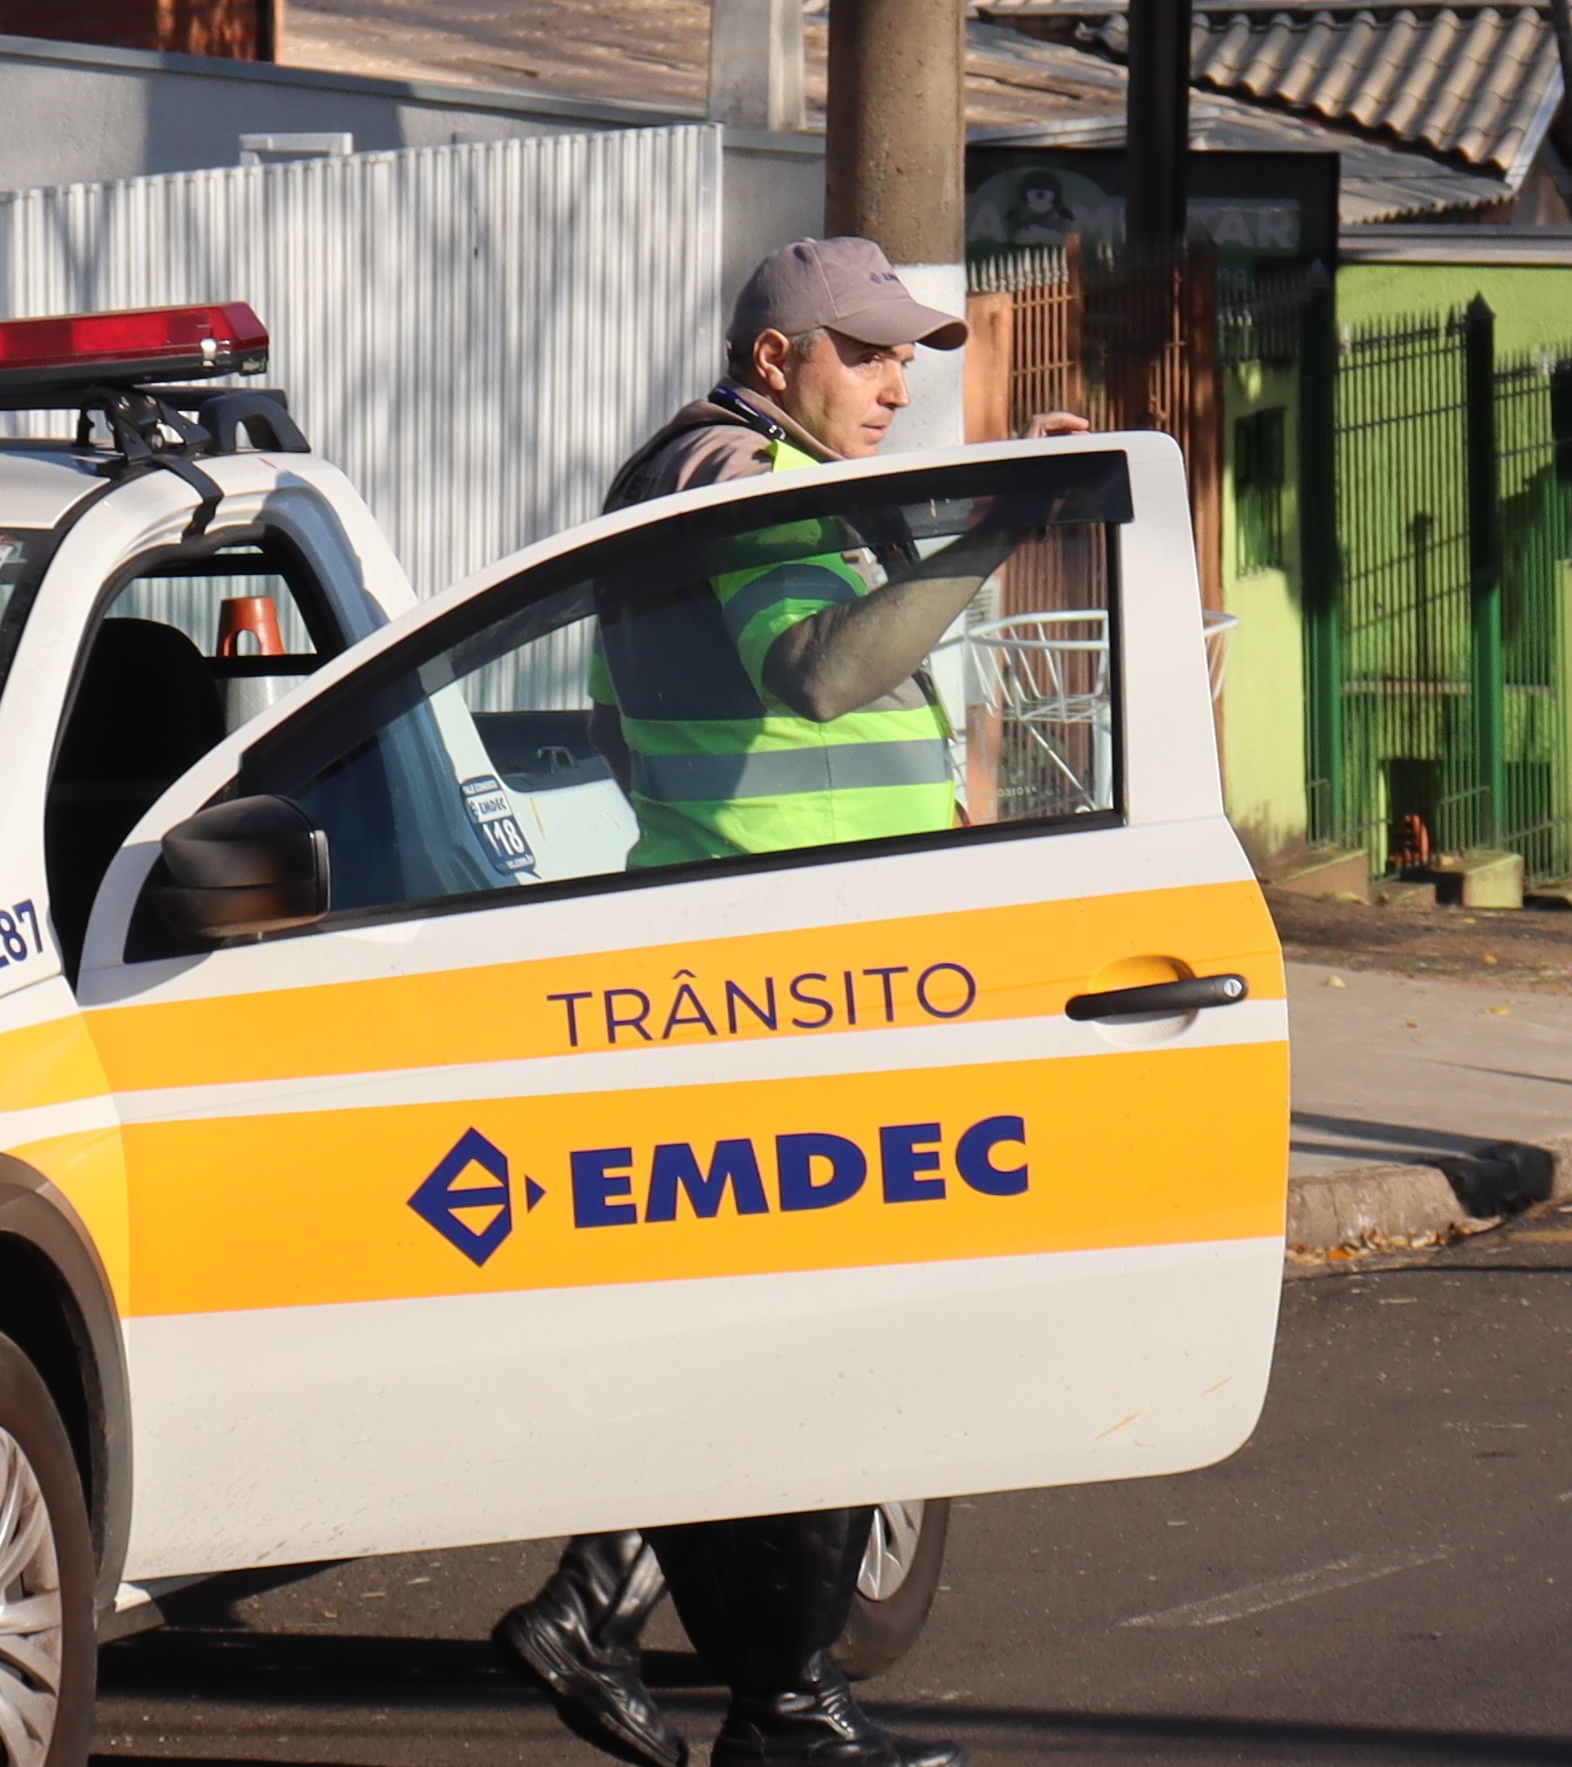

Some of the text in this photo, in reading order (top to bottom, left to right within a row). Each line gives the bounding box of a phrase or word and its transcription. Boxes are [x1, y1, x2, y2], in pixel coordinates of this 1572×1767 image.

[482, 818, 525, 858] 118
[545, 962, 977, 1048] TRÂNSITO
[569, 1114, 1030, 1230] EMDEC
